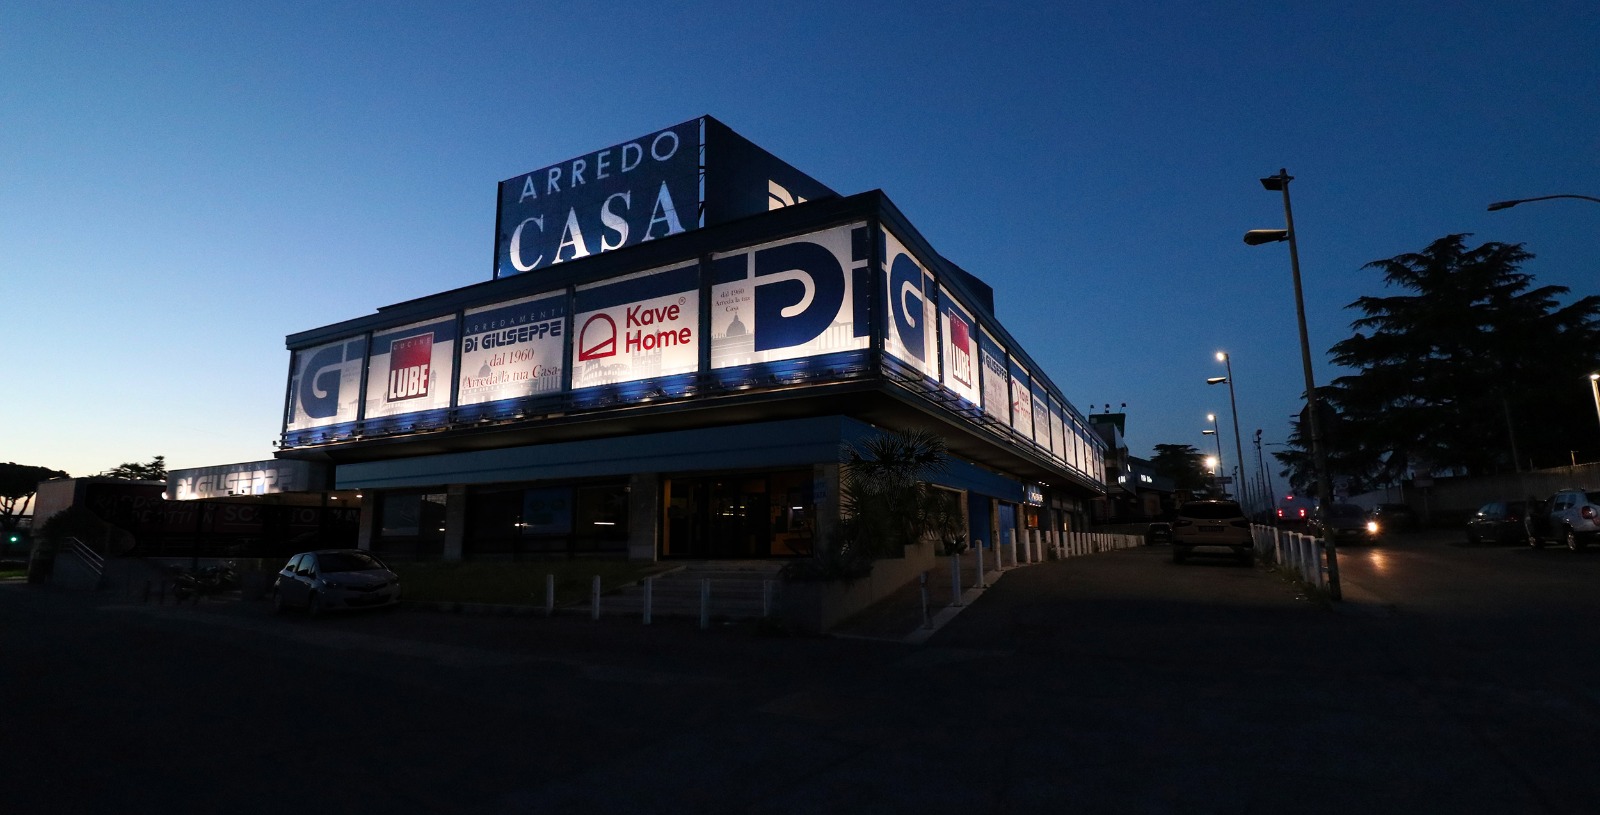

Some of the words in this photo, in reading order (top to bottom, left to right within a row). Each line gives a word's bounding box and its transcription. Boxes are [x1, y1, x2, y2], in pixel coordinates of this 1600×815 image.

[518, 130, 680, 204] ARREDO
[509, 180, 686, 273] CASA
[465, 308, 564, 334] ARREDAMENTI
[626, 304, 680, 329] Kave
[393, 336, 432, 351] CUCINE
[625, 327, 692, 354] Home
[489, 352, 506, 367] dal
[509, 347, 535, 364] 1960
[388, 363, 429, 399] LUBE
